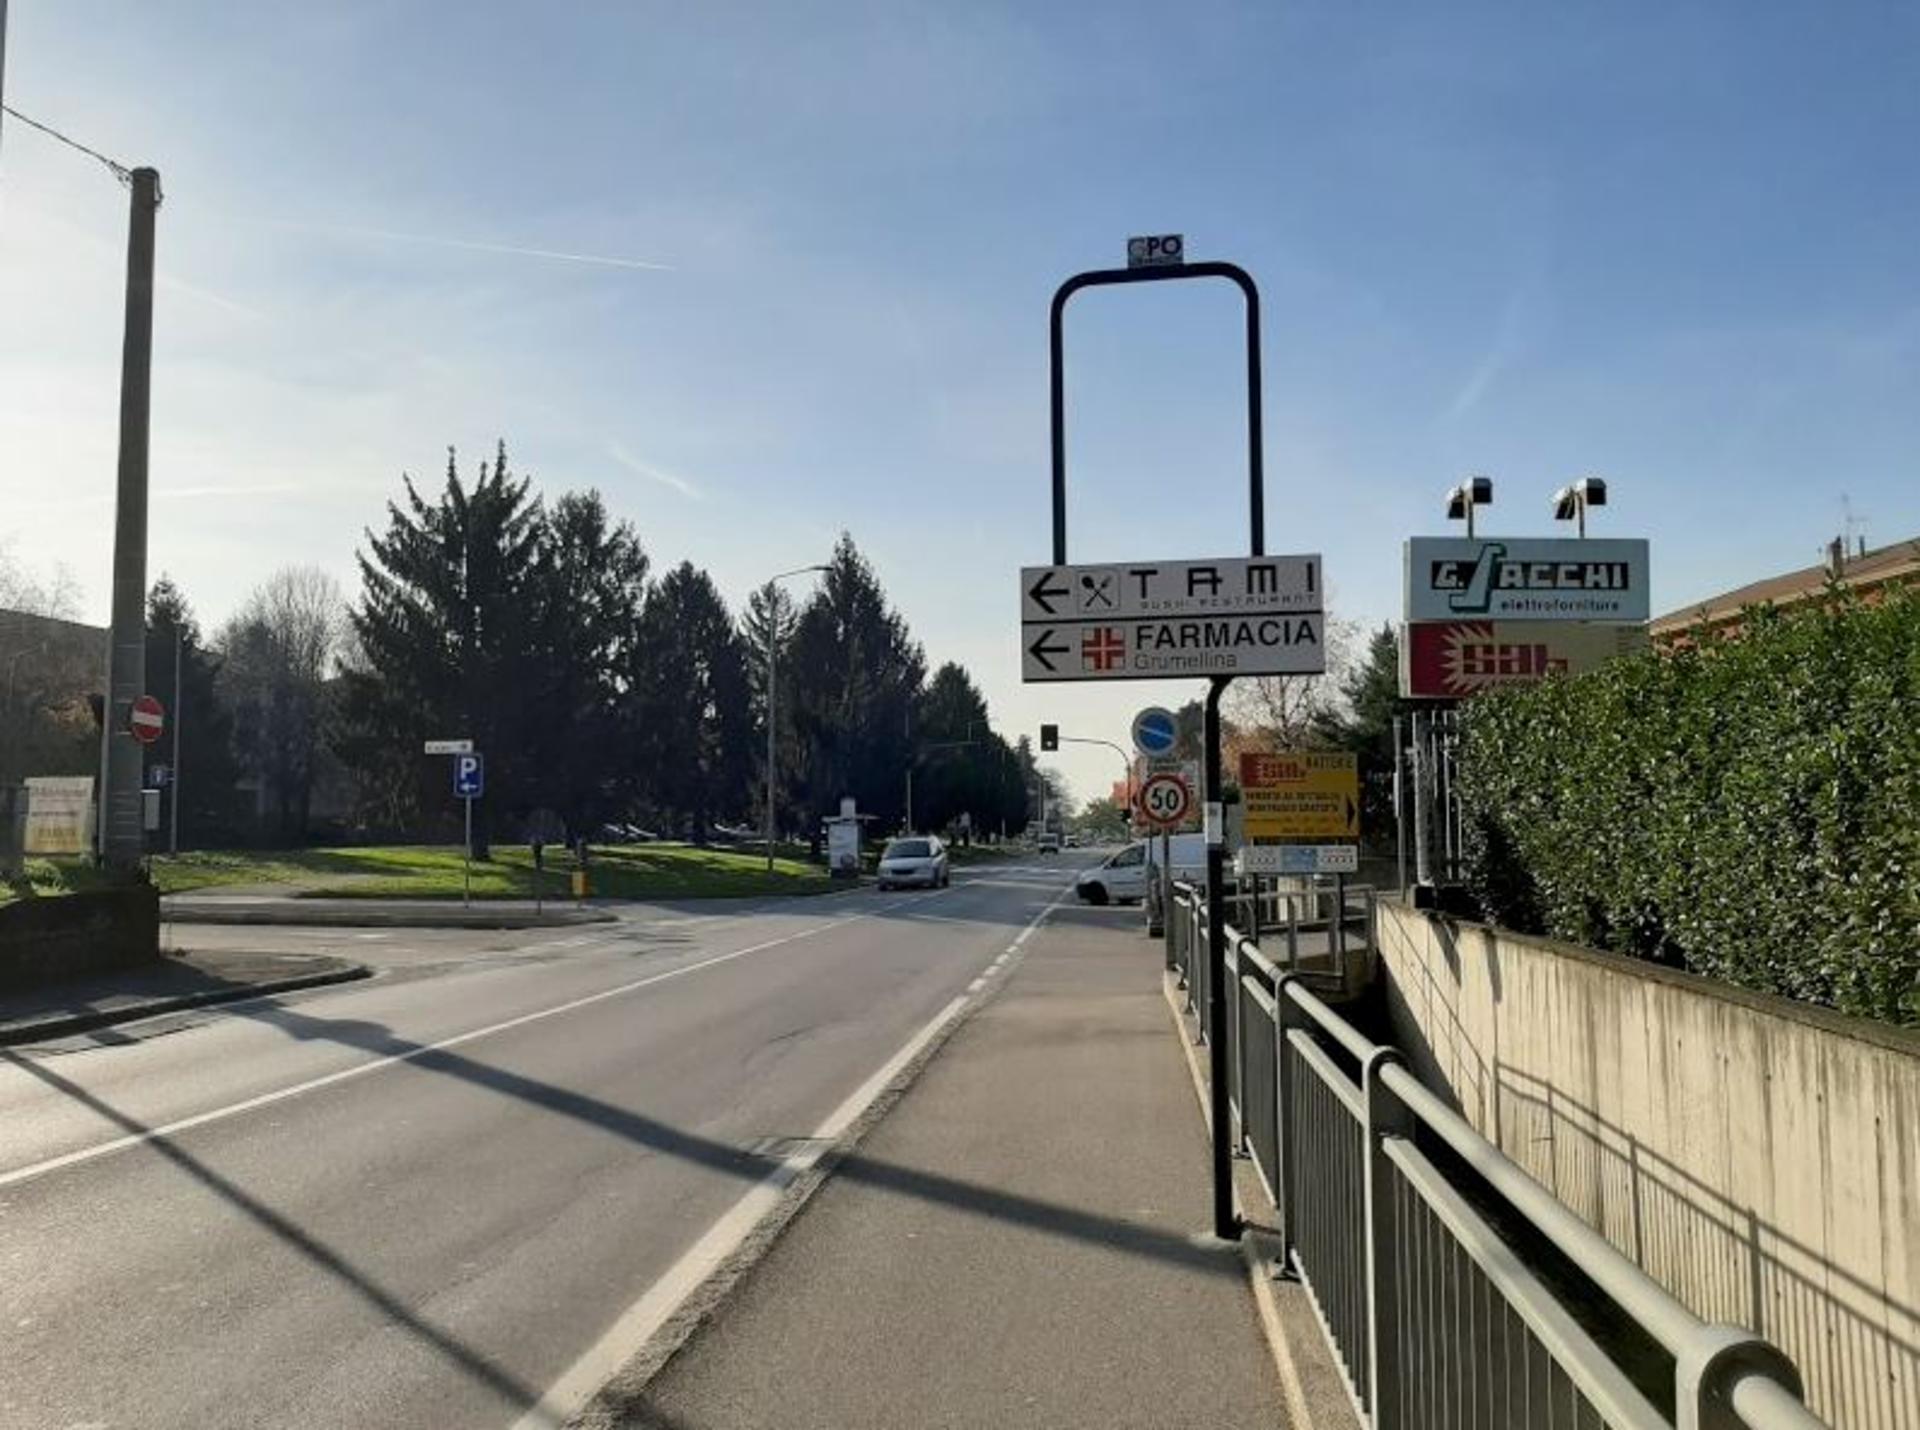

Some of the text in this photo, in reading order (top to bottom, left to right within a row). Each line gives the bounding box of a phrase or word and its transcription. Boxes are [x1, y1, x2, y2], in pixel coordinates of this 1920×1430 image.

[1130, 562, 1315, 599] TAMI
[1136, 619, 1318, 650] FARMACIA
[1134, 651, 1238, 670] Grumellina
[461, 758, 477, 780] P
[1151, 788, 1179, 810] 50
